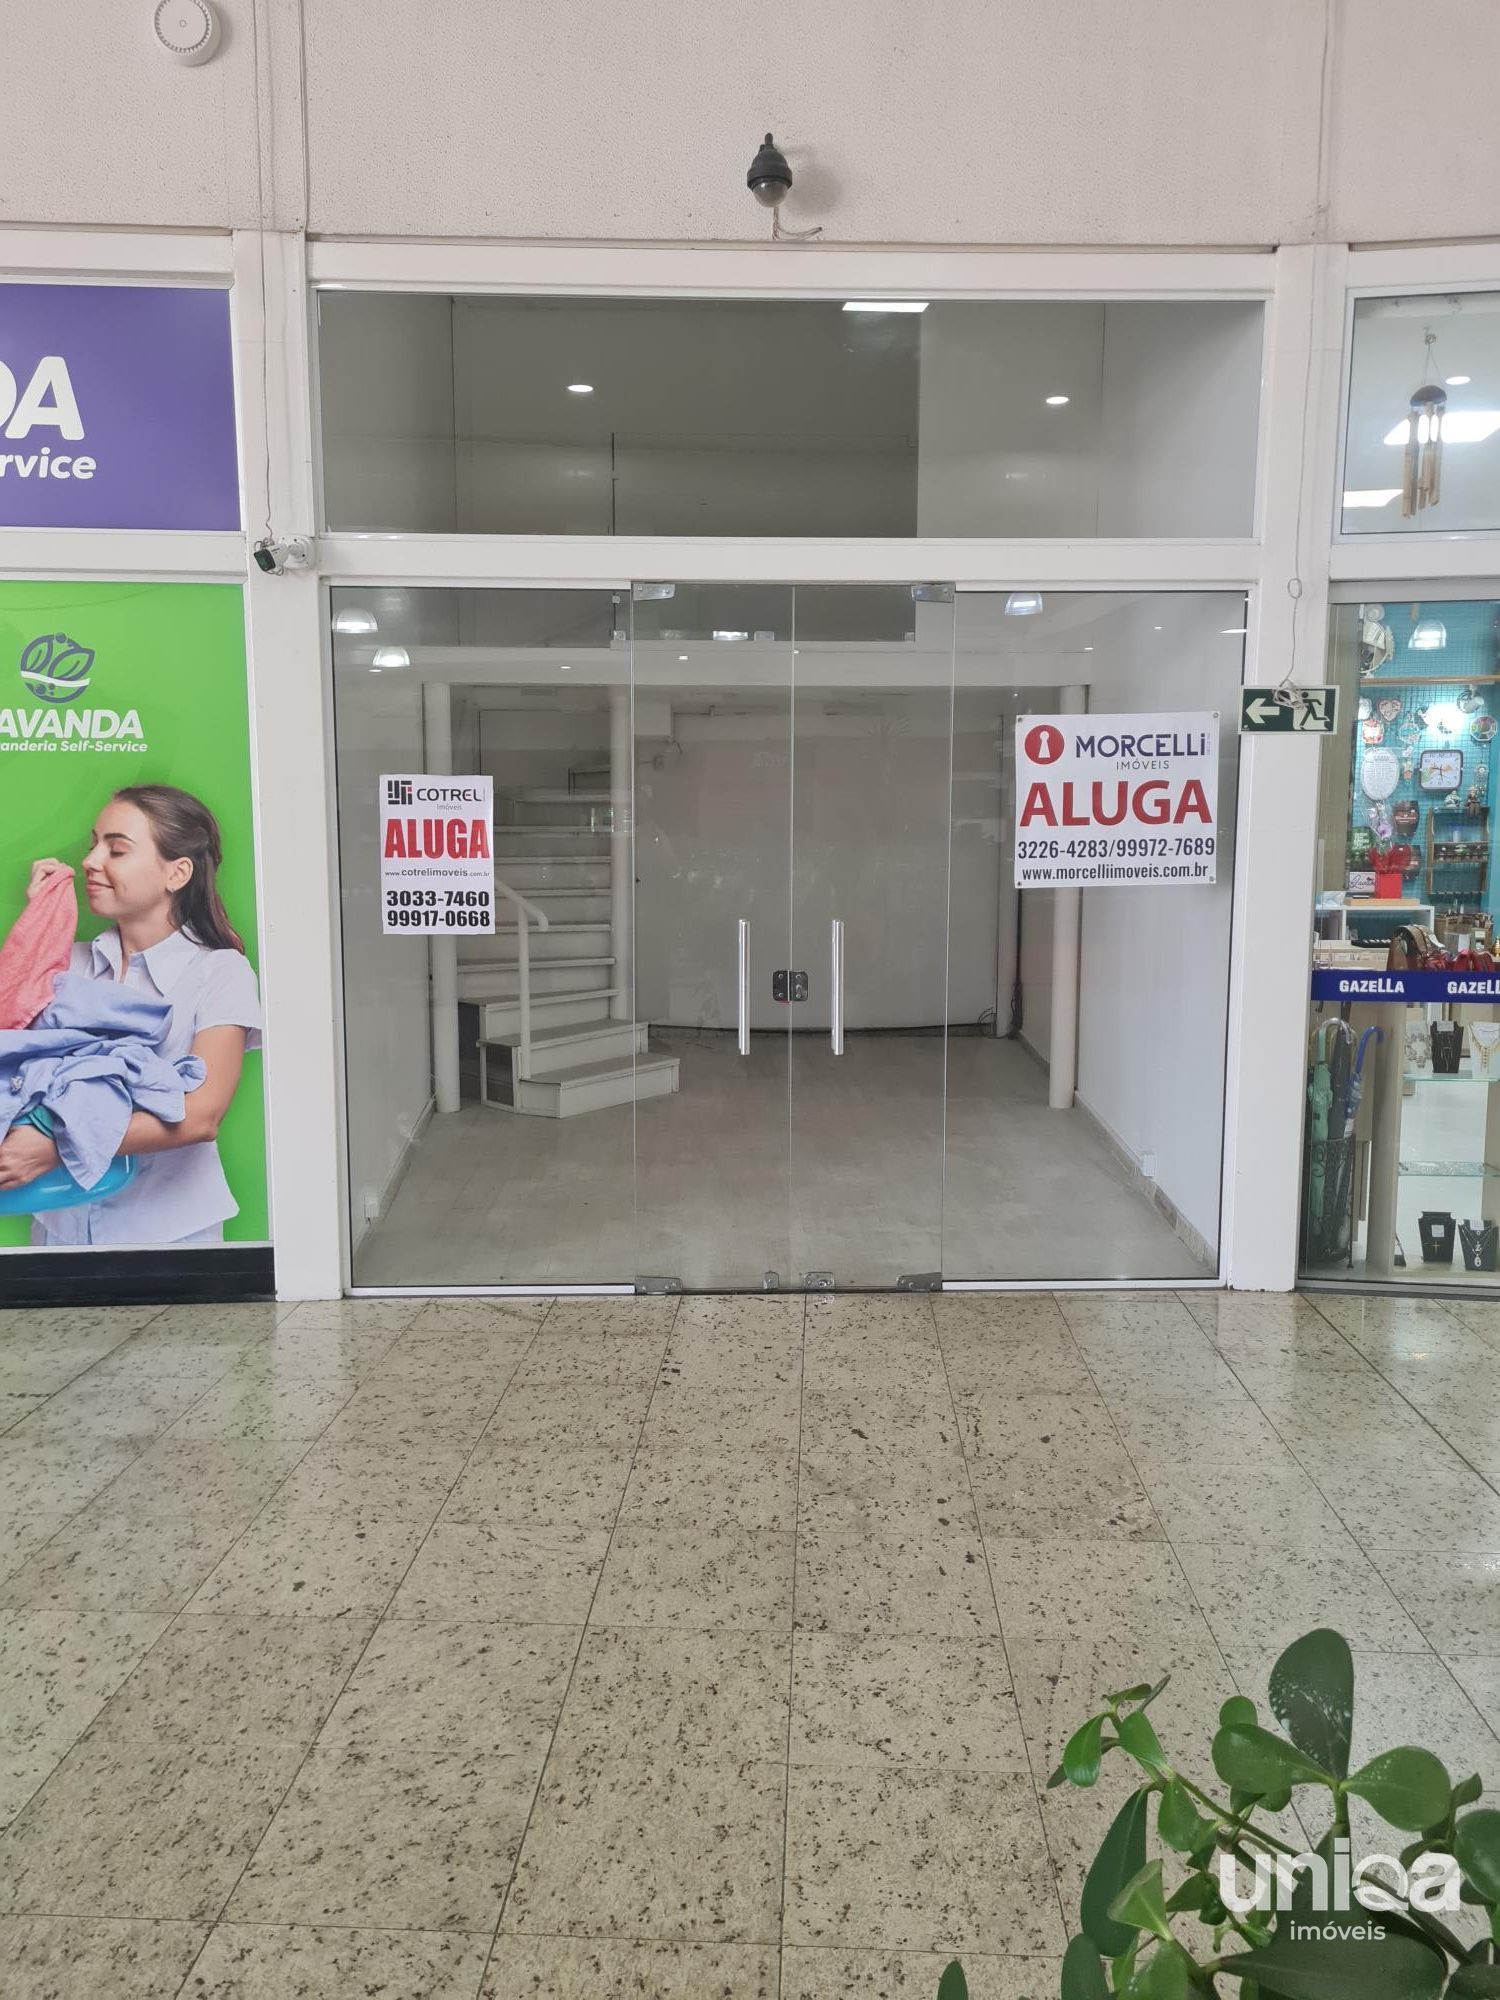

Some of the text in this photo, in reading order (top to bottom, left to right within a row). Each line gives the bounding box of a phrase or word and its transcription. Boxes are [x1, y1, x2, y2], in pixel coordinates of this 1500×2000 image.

[0, 356, 85, 441] A
[0, 447, 97, 479] rvice
[0, 709, 144, 739] AVANDA
[0, 740, 148, 752] anderia Self-Service
[1116, 758, 1170, 770] IMÓVEIS
[416, 788, 482, 802] COTREL
[1019, 779, 1213, 827] ALUGA
[384, 818, 490, 859] ALUGA
[1018, 837, 1215, 859] 3226-4283/99972-7689
[1022, 862, 1209, 881] www.morcelliimoveis.com.br
[386, 890, 490, 907] 3033-7460
[387, 910, 490, 927] 99917-0668
[1339, 978, 1405, 993] GAZELLA
